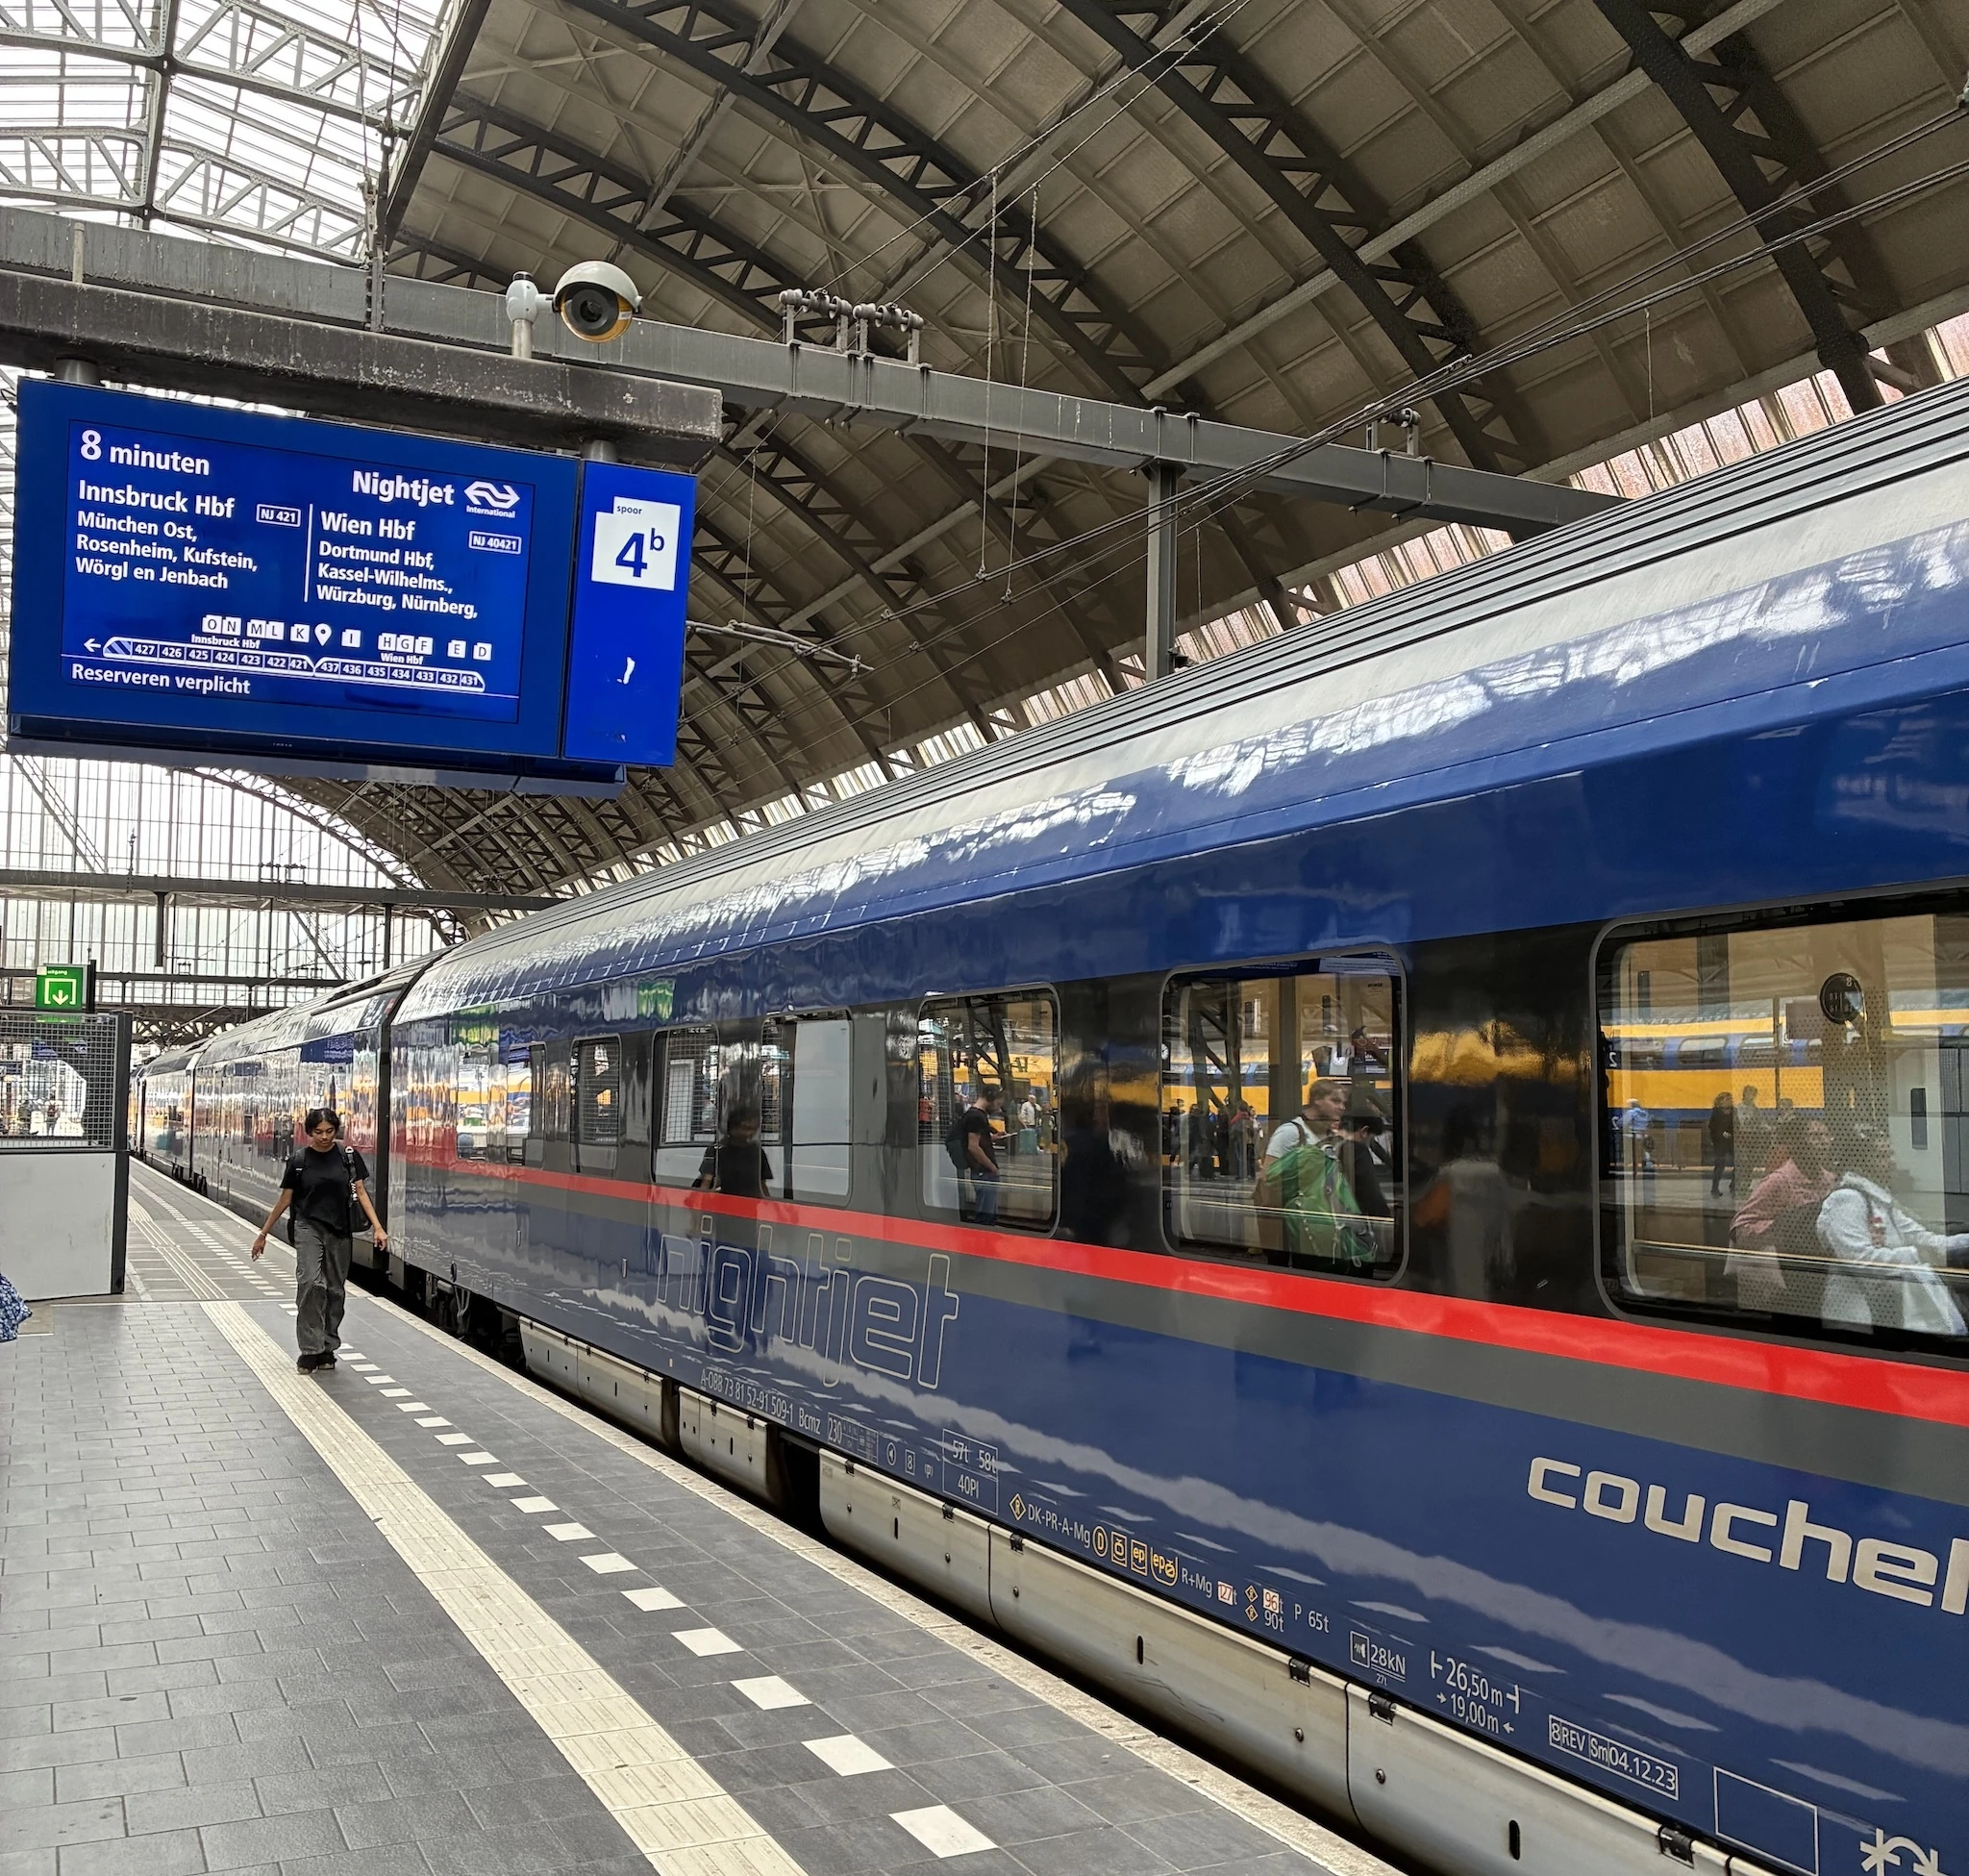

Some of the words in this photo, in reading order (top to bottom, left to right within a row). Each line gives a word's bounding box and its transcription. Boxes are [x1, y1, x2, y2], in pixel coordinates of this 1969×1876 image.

[80, 429, 102, 461] 8
[110, 444, 211, 477] minuten
[79, 479, 188, 513] Innsbruck
[194, 494, 237, 519] Hbf
[352, 469, 455, 508] Nightjet
[77, 510, 159, 538] München
[162, 521, 198, 542] Ost,
[261, 508, 274, 521] NJ
[277, 510, 296, 523] 421
[320, 510, 373, 537] Wien
[378, 517, 415, 542] Hbf
[465, 505, 516, 518] International
[616, 505, 643, 516] spoor
[77, 534, 178, 563] Rosenheim,
[183, 546, 259, 573] Kufstein,
[318, 540, 400, 566] Dortmund
[404, 549, 436, 571] Hbf,
[472, 535, 486, 547] NJ
[487, 537, 517, 552] 40421
[75, 556, 129, 580] Wörgl
[133, 565, 156, 582] en
[159, 566, 229, 590] Jenbach
[317, 562, 454, 595] Kassel-Wilhelms.,
[316, 584, 397, 611] Würzburg,
[401, 594, 479, 620] Nürnberg,
[191, 634, 240, 647] Innsbruck
[242, 638, 261, 650] Hbf
[135, 643, 155, 656] 427
[162, 646, 182, 659] 426
[188, 649, 209, 662] 425
[215, 652, 235, 664] 424
[241, 654, 261, 666] 423
[267, 656, 287, 669] 422
[289, 658, 308, 671] 421
[320, 661, 339, 673] 437
[342, 663, 361, 676] 436
[367, 664, 386, 678] 435
[391, 667, 411, 680] 434
[416, 670, 435, 683] 433
[440, 673, 459, 685] 432
[461, 674, 479, 687] 431
[381, 652, 405, 663] Wien
[407, 654, 424, 665] Hbf
[72, 663, 170, 688] Reserveren
[175, 675, 251, 695] verplicht
[657, 1214, 960, 1389] nightjet
[724, 1377, 734, 1398] 73
[735, 1382, 744, 1402] 81
[747, 1386, 768, 1413] 52-91
[771, 1395, 794, 1423] 509-1
[798, 1407, 821, 1435] Bcmz
[828, 1417, 842, 1444] 230
[952, 1439, 969, 1463] 57t
[978, 1449, 997, 1474] 58t
[1028, 1503, 1090, 1549] DK-PR-A-Mg
[1181, 1566, 1212, 1598] R+Mg
[1264, 1609, 1284, 1633] 90t
[1294, 1603, 1302, 1621] P
[1308, 1609, 1330, 1634] 65t
[1370, 1643, 1406, 1675] 28kN
[1562, 1725, 1586, 1752] REV
[1590, 1737, 1608, 1763] Sm
[1608, 1741, 1677, 1791] 04.12.23
